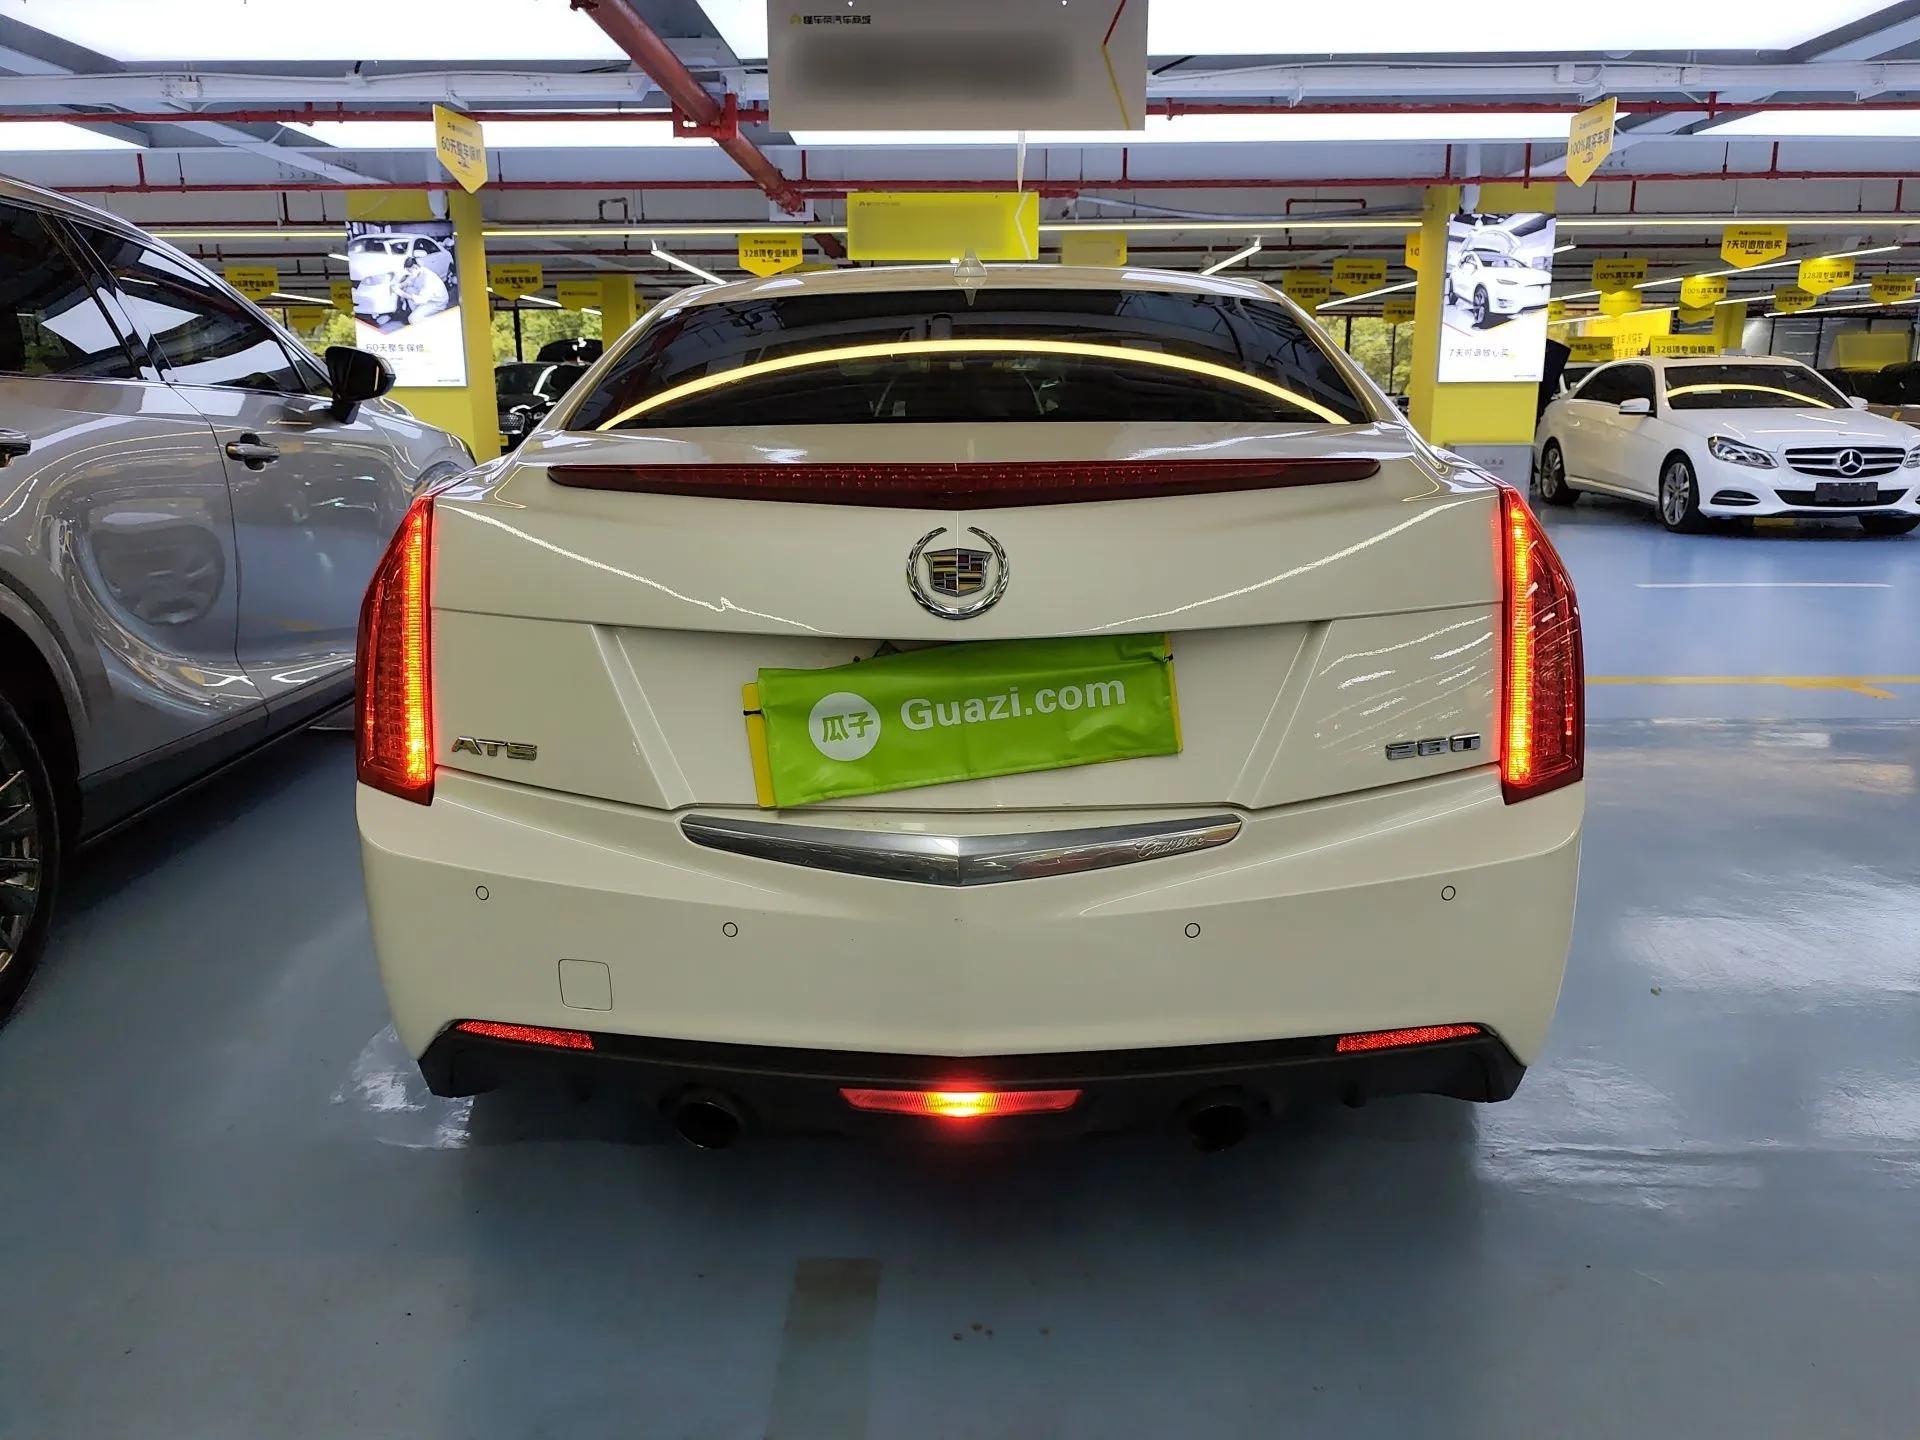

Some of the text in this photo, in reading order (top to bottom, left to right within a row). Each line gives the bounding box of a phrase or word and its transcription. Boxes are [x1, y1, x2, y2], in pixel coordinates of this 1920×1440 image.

[900, 679, 1127, 731] Guazi.com
[821, 711, 874, 743] 瓜子
[1134, 837, 1205, 858] Cadillac
